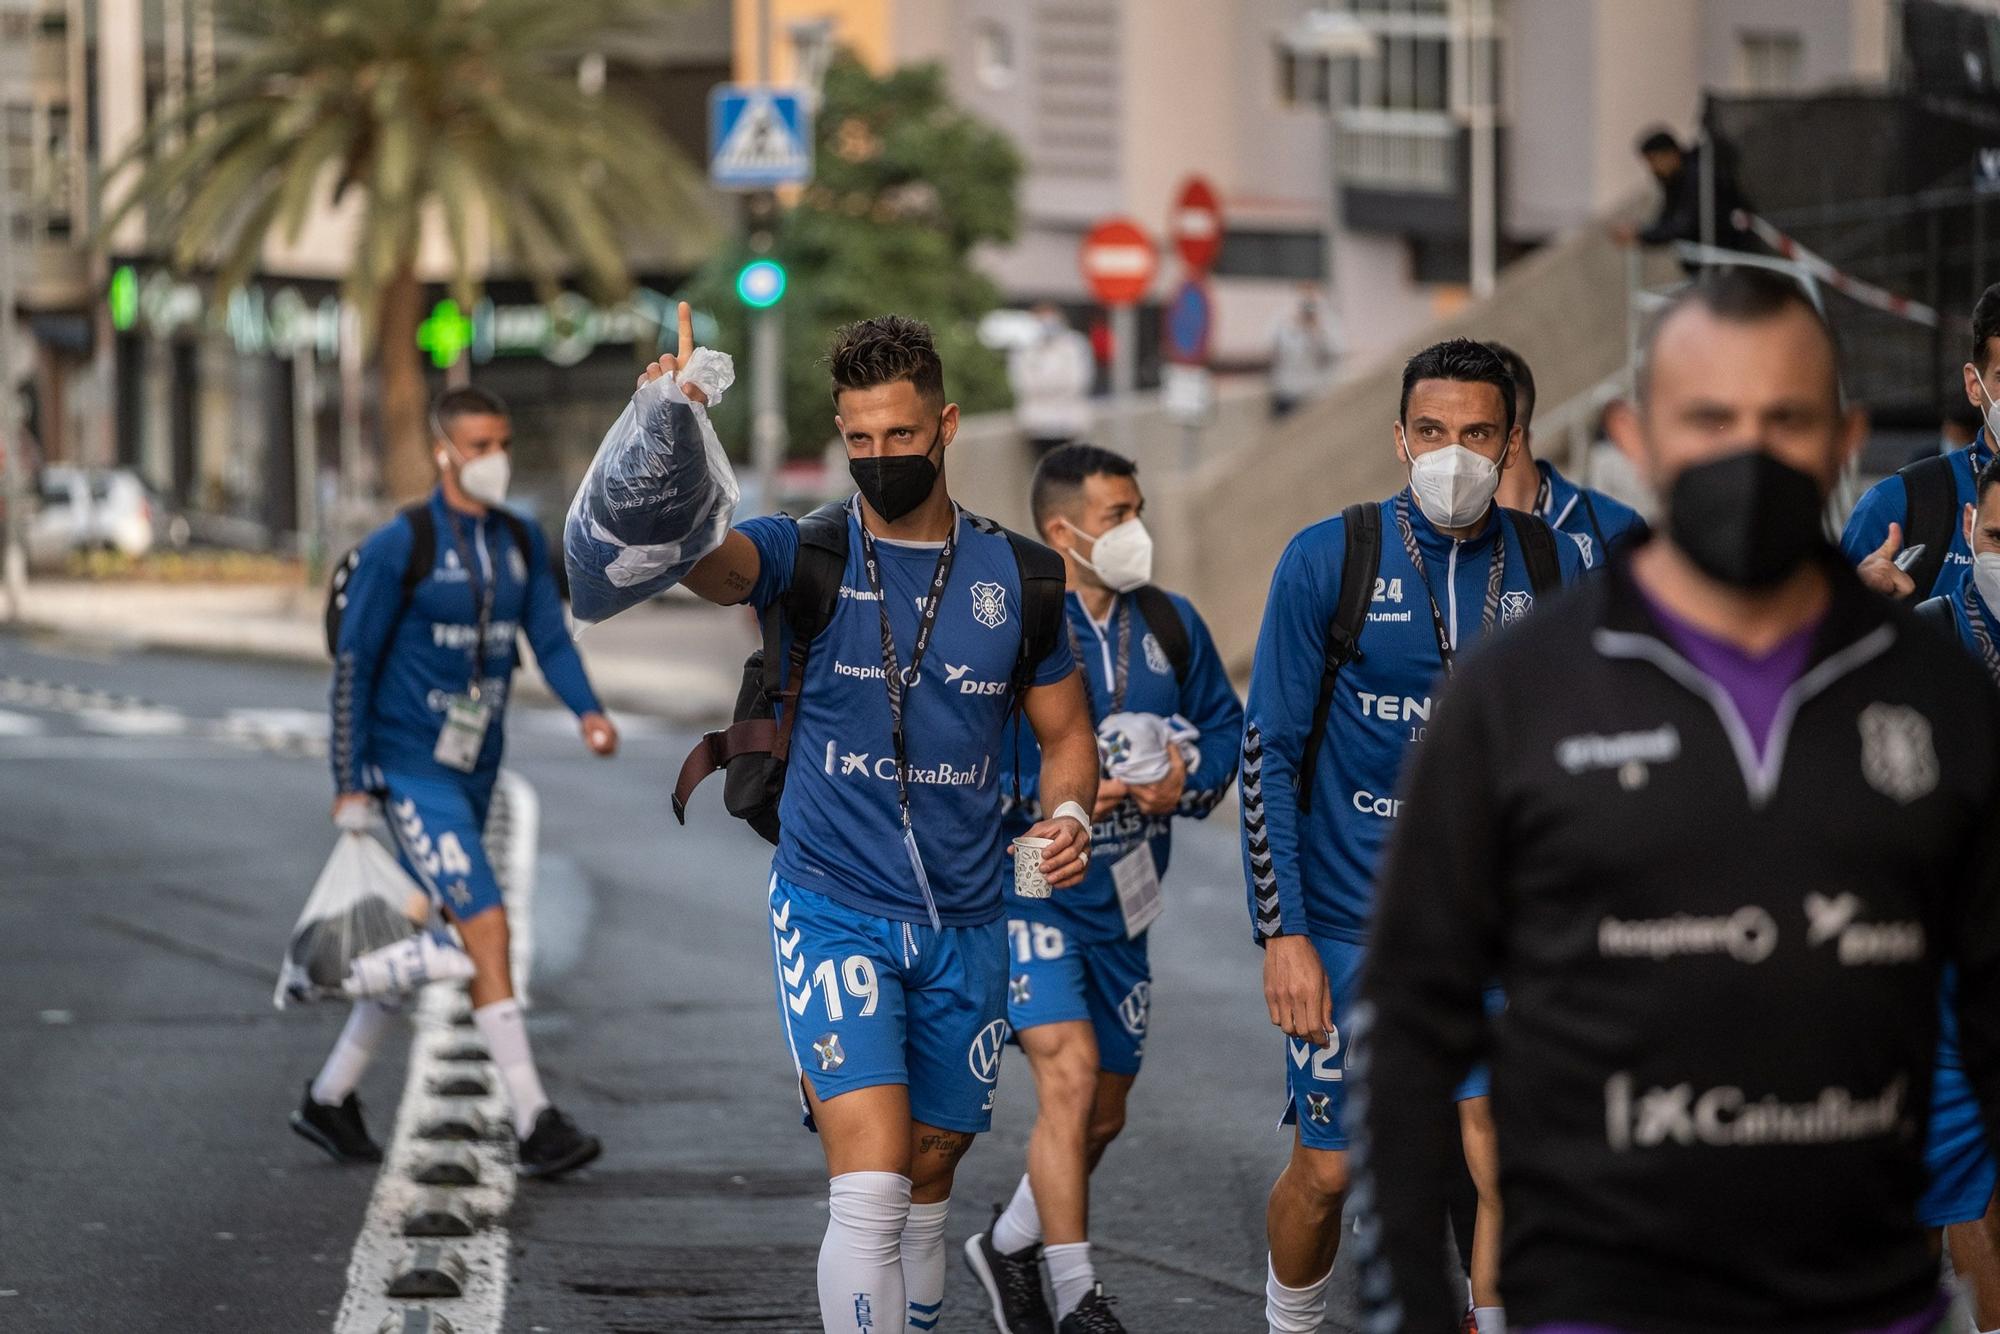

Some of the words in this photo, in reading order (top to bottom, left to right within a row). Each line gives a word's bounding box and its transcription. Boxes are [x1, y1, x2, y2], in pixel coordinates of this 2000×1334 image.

[1954, 552, 1974, 565] hu
[1371, 577, 1403, 603] 24
[834, 660, 886, 680] hospite
[1356, 691, 1432, 722] TEN
[874, 757, 977, 785] CixaBank
[812, 954, 880, 1022] 19
[1311, 1024, 1353, 1081] 2
